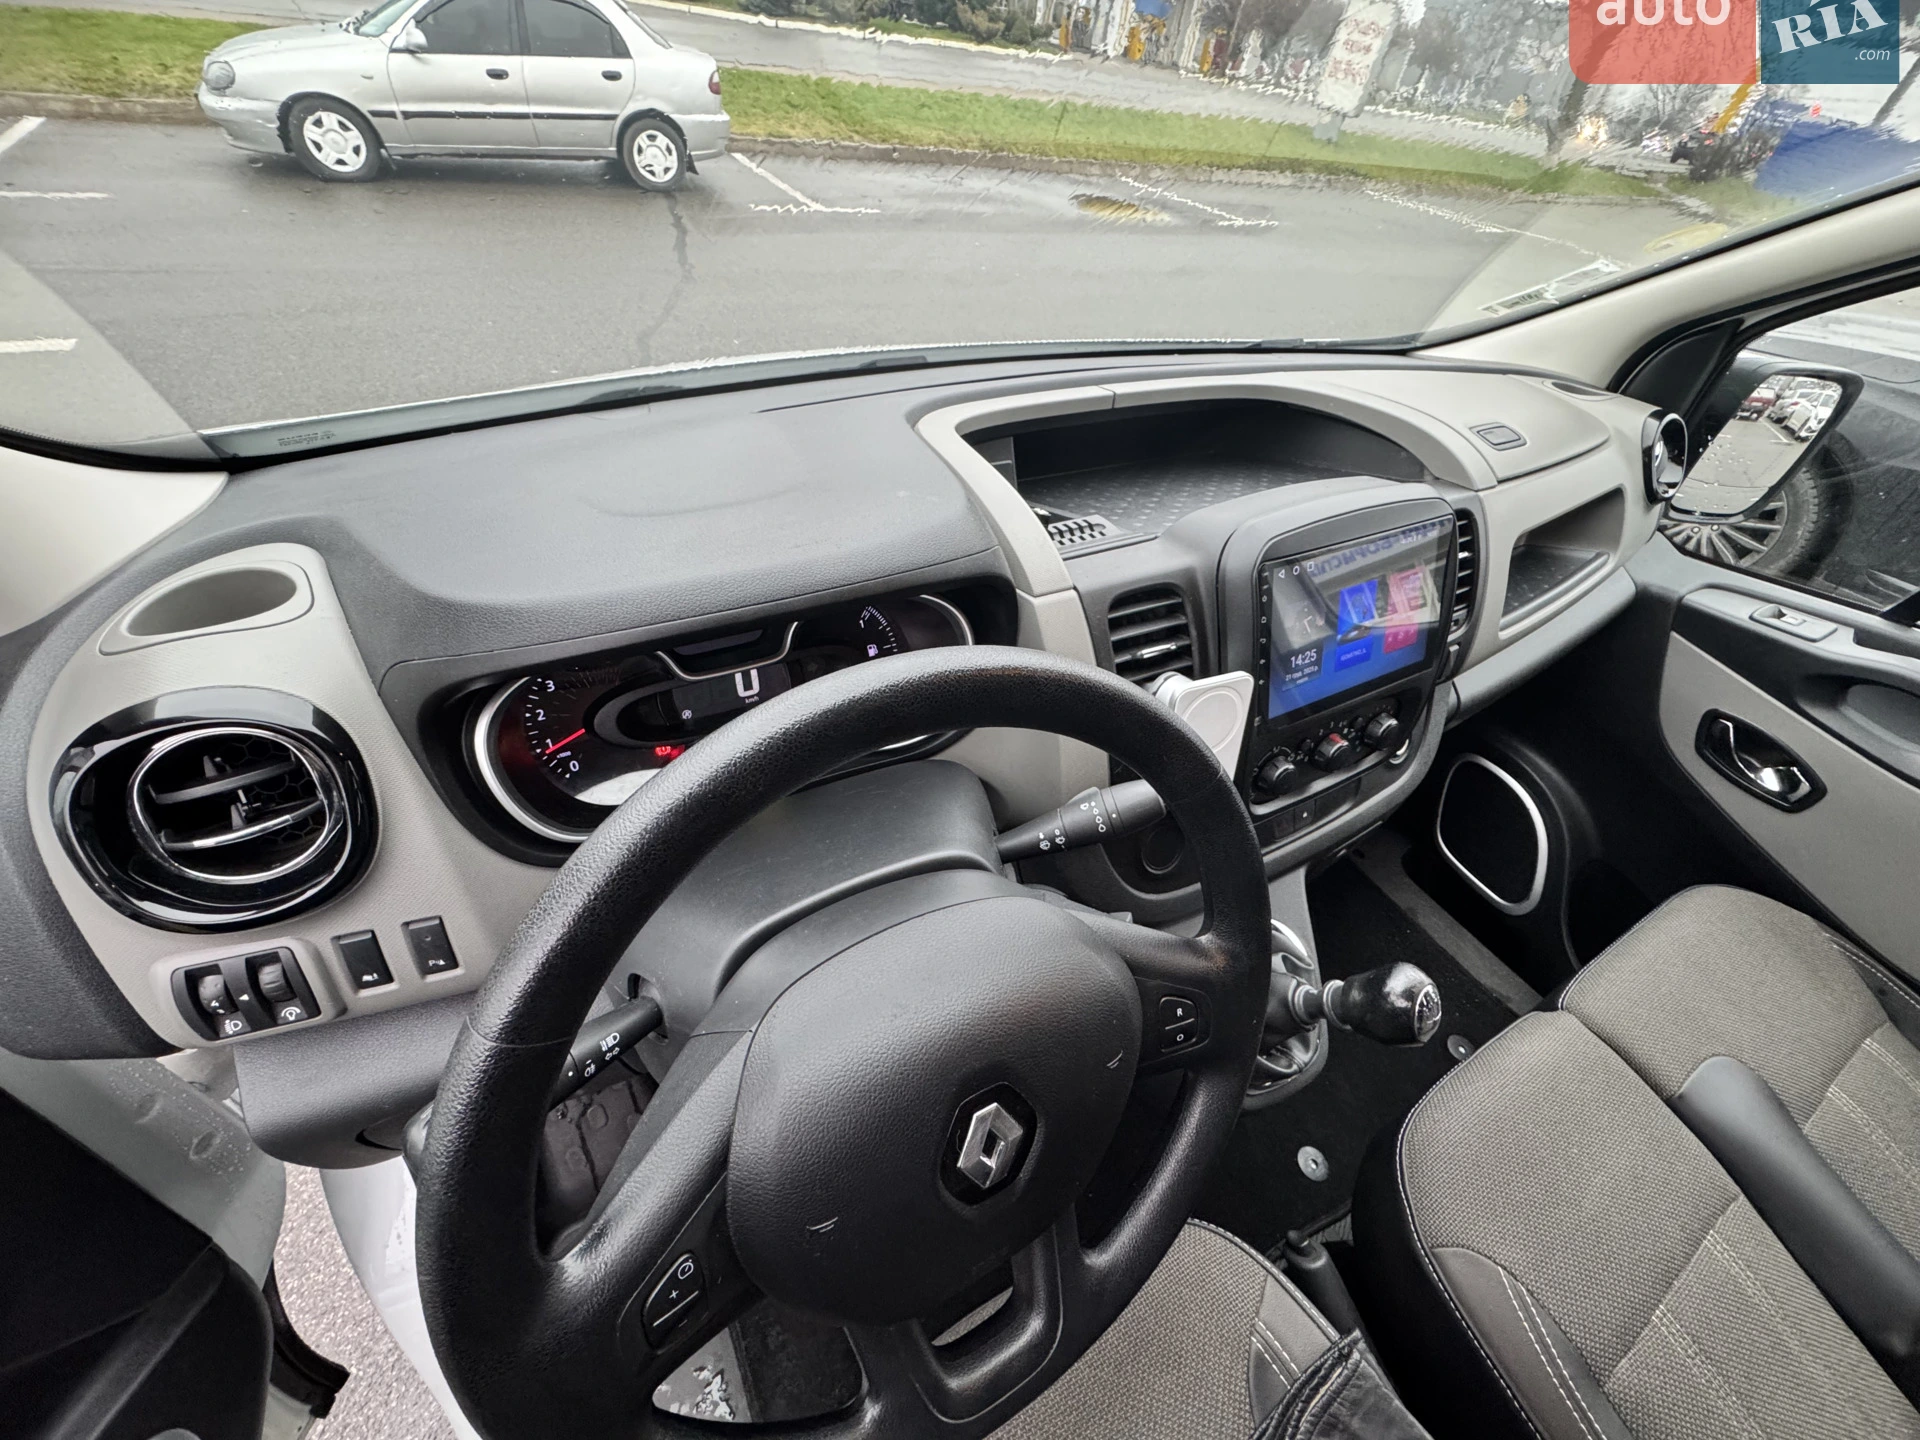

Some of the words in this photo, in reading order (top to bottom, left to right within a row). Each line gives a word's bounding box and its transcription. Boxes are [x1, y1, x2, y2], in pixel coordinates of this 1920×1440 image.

[1290, 648, 1317, 668] 14:25
[544, 680, 556, 692] 3
[535, 709, 546, 721] 2
[569, 760, 580, 772] 0
[1176, 1007, 1183, 1017] R
